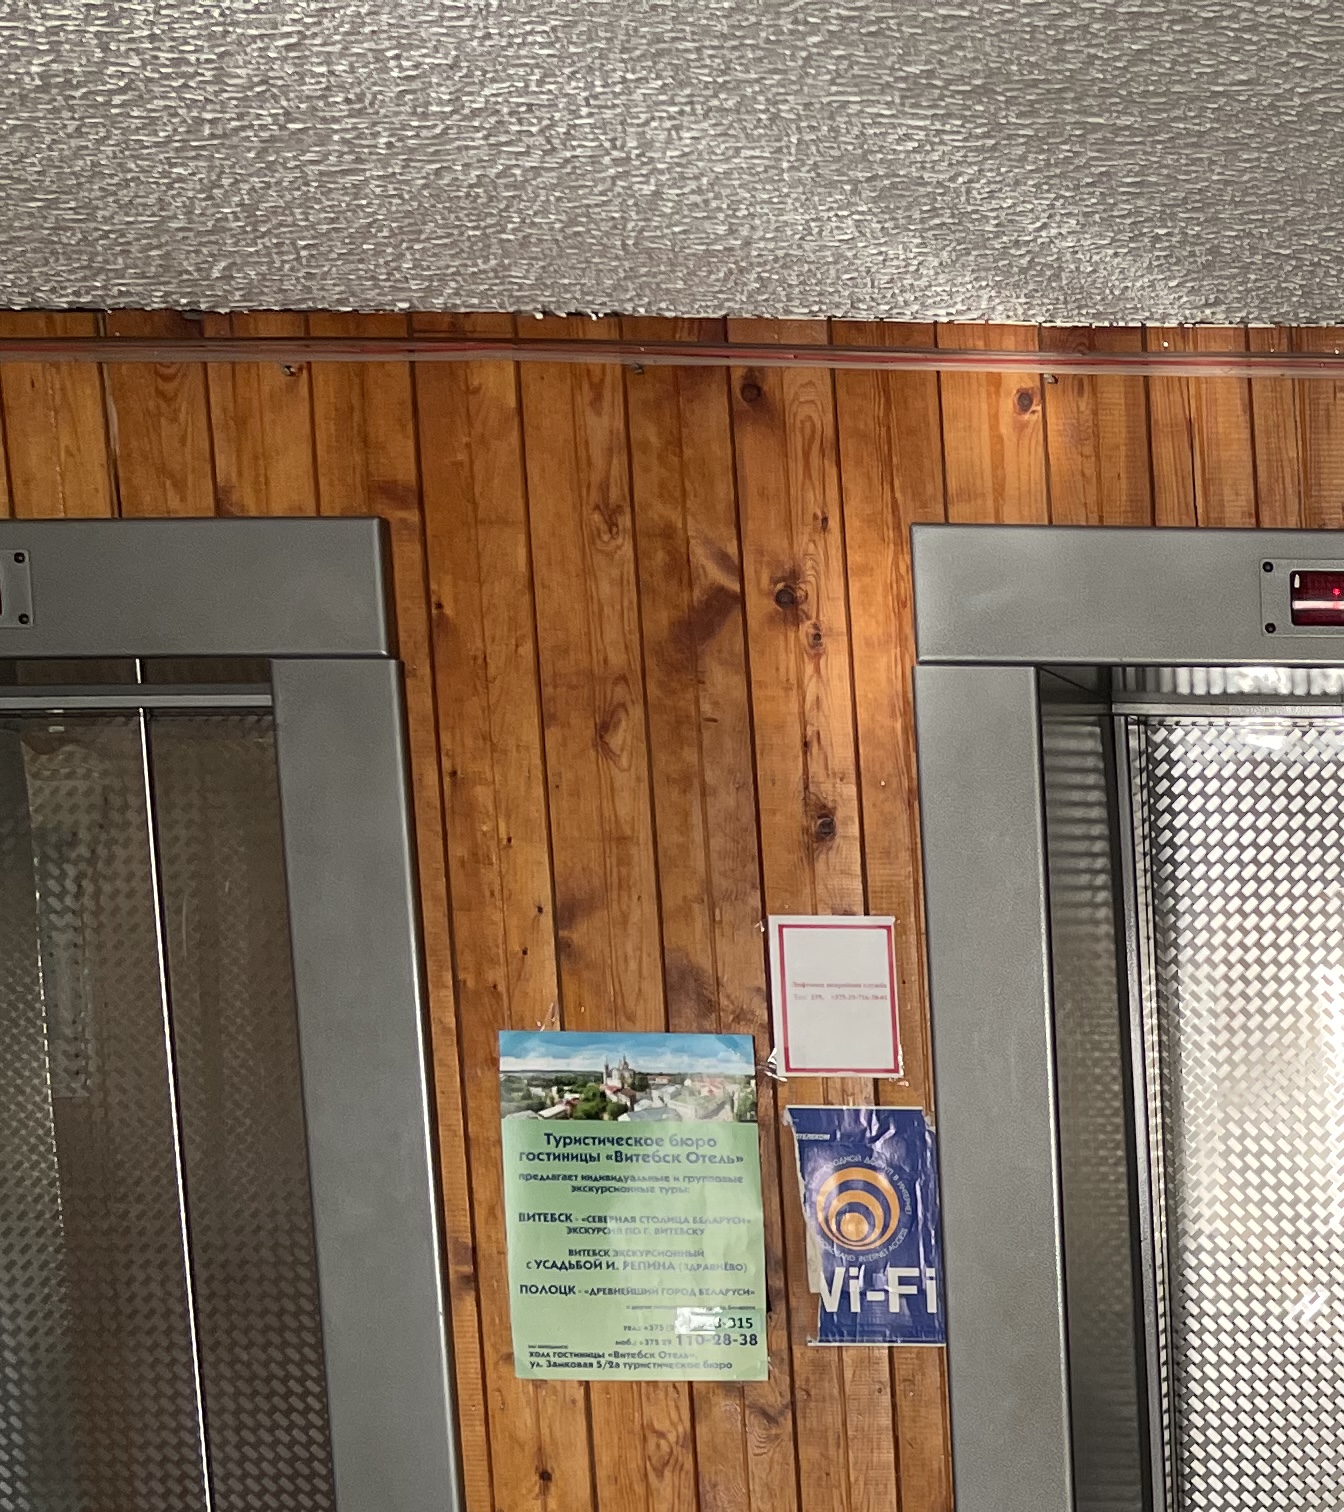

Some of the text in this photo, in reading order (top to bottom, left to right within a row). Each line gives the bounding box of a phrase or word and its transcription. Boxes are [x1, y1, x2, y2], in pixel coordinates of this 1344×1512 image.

[544, 1133, 718, 1150] Туристическое бюро
[520, 1151, 745, 1165] гостиницы «Витебск Отель»
[519, 1212, 573, 1223] ВИТЕБСК
[582, 1214, 637, 1224] «СЕВЕРНАЯ
[639, 1216, 690, 1224] СТОЛИЦА
[568, 1248, 611, 1258] ВИТЕБСК
[534, 1258, 603, 1272] УСАДЬБОЙ
[606, 1260, 619, 1271] И.
[623, 1260, 676, 1271] РЕПИНА
[520, 1284, 576, 1297] ПОЛОЦК
[661, 1288, 697, 1297] ГОРОД
[675, 1333, 758, 1347] 110-28-38
[702, 1360, 733, 1371] бюро
